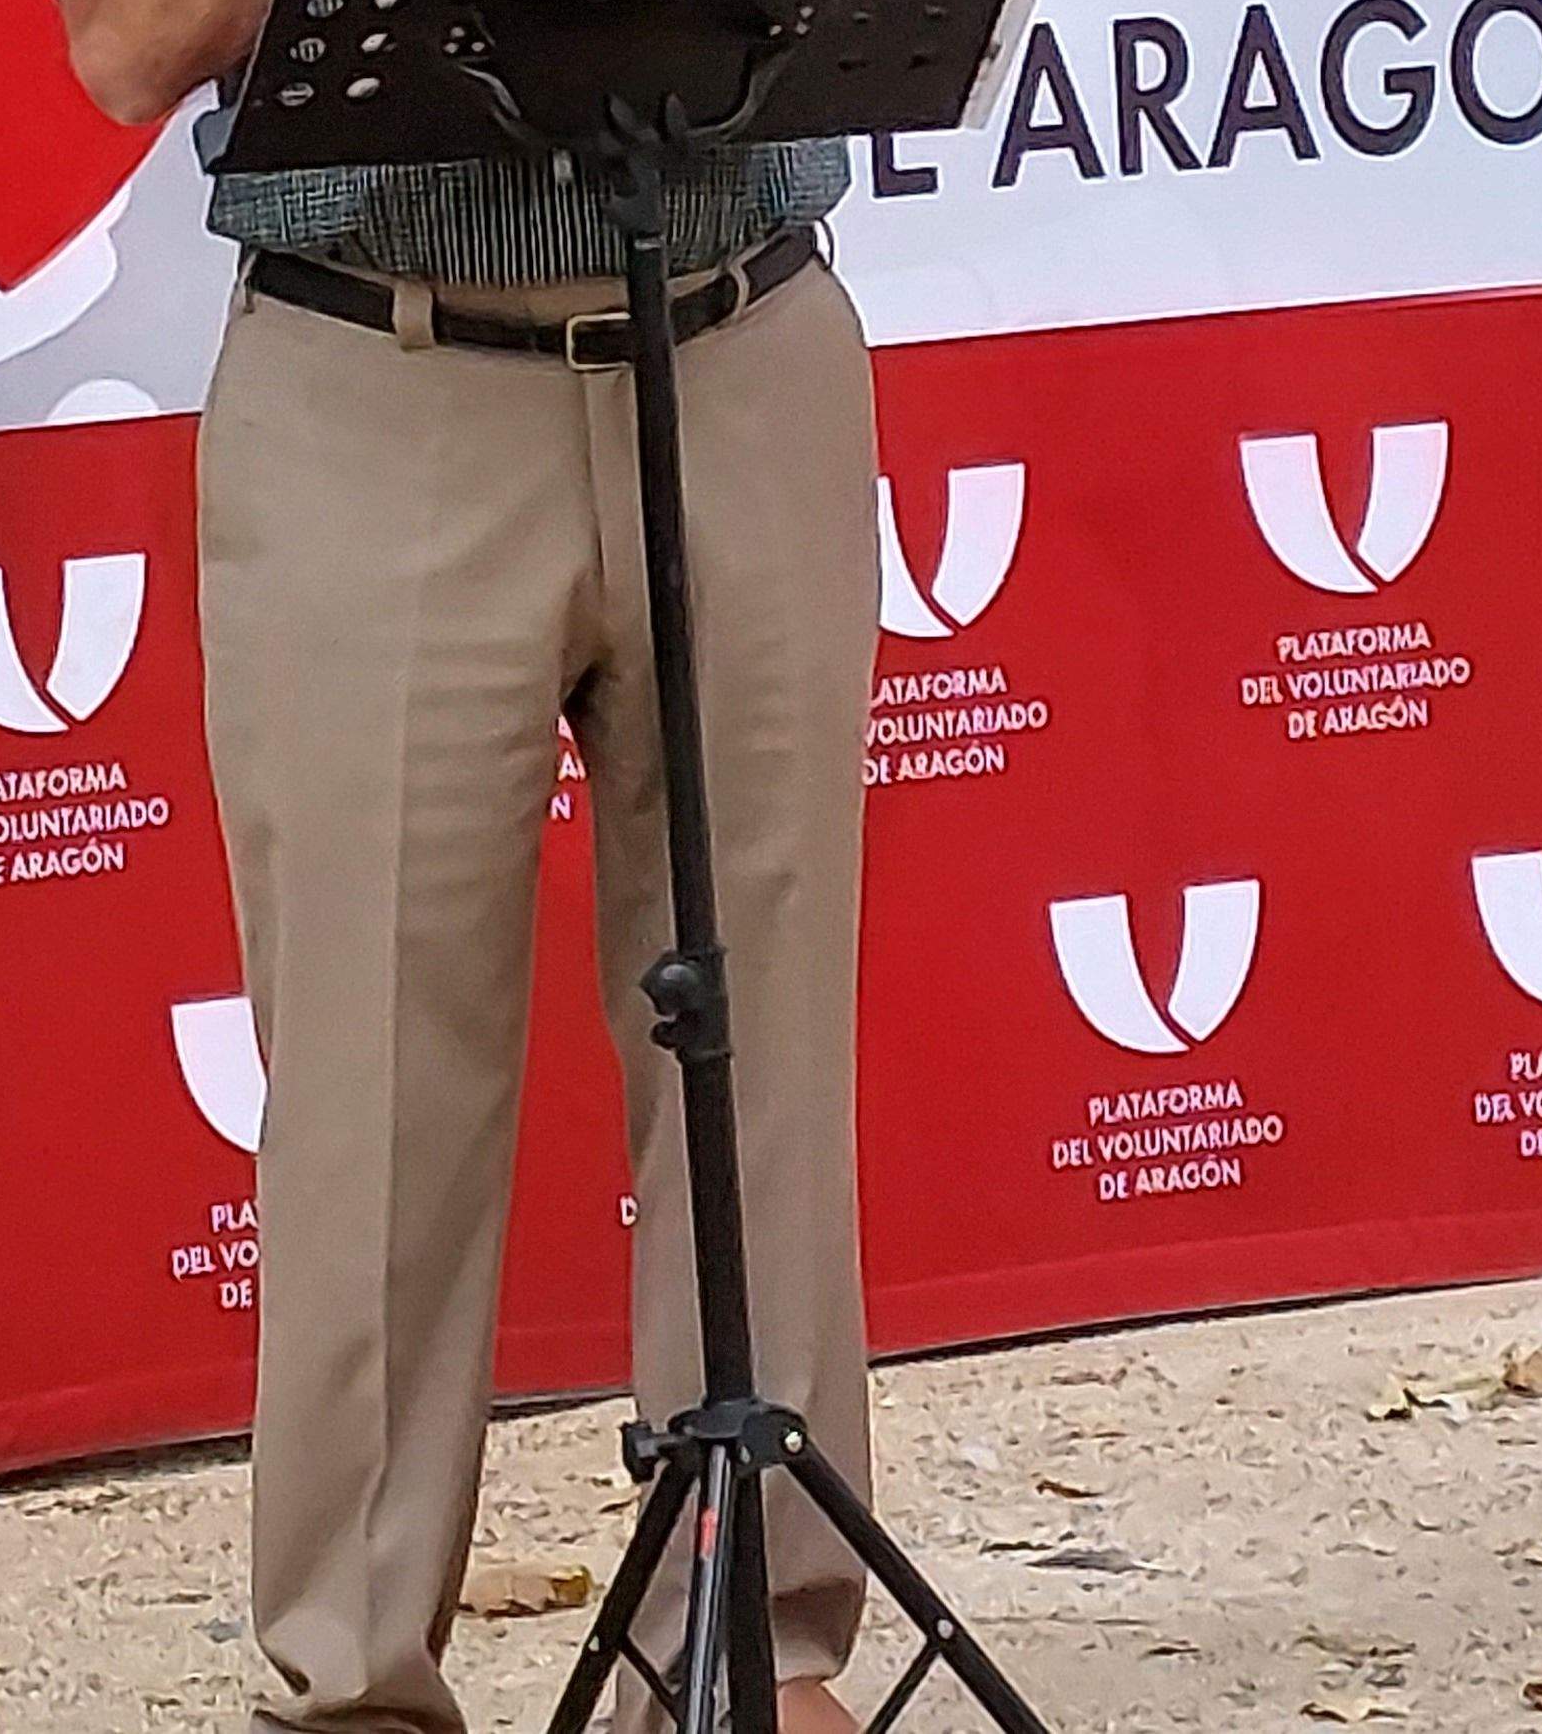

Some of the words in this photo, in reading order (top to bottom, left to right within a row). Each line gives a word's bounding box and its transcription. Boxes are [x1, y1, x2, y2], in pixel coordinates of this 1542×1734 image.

[1275, 621, 1432, 663] PLATAFORMA
[870, 665, 1008, 708] ATAFORMA
[1240, 675, 1284, 706] DEL
[1285, 656, 1471, 701] VOLUNTARIADO
[1287, 709, 1318, 740] DE
[1322, 693, 1429, 735] ARAGÓN
[895, 739, 1006, 782] ARAGÓN
[9, 836, 125, 882] ARAGÓN
[1087, 1079, 1244, 1127] PLATAFORMA
[1473, 1092, 1517, 1124] DEL
[1052, 1137, 1094, 1170] DEL
[1096, 1114, 1284, 1162] VOLUNTARIADO
[1098, 1170, 1130, 1201] DE
[1134, 1153, 1242, 1195] ARAGÓN
[170, 1244, 217, 1284] DEL
[218, 1277, 254, 1310] DE
